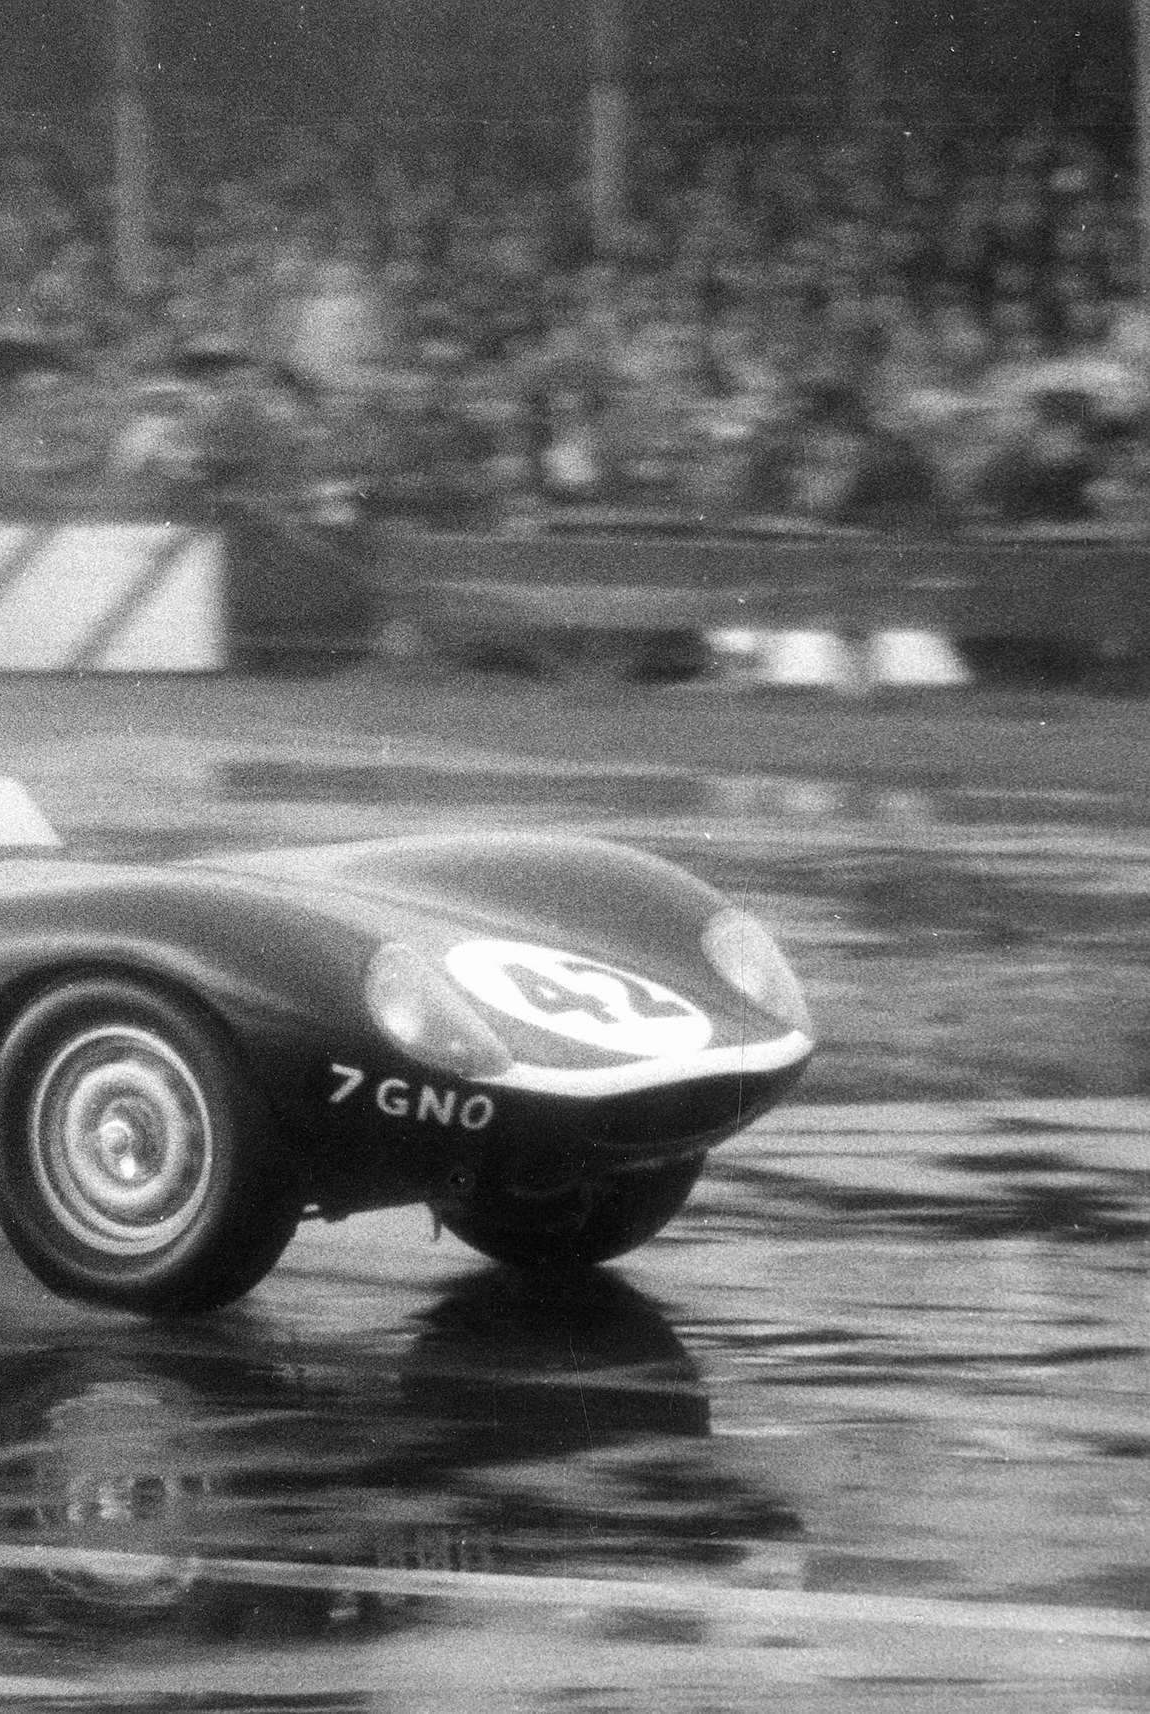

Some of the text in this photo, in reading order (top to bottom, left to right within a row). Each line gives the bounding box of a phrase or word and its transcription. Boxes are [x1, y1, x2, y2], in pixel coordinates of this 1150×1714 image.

[500, 960, 695, 1025] 42
[329, 1062, 495, 1130] 7 GNO
